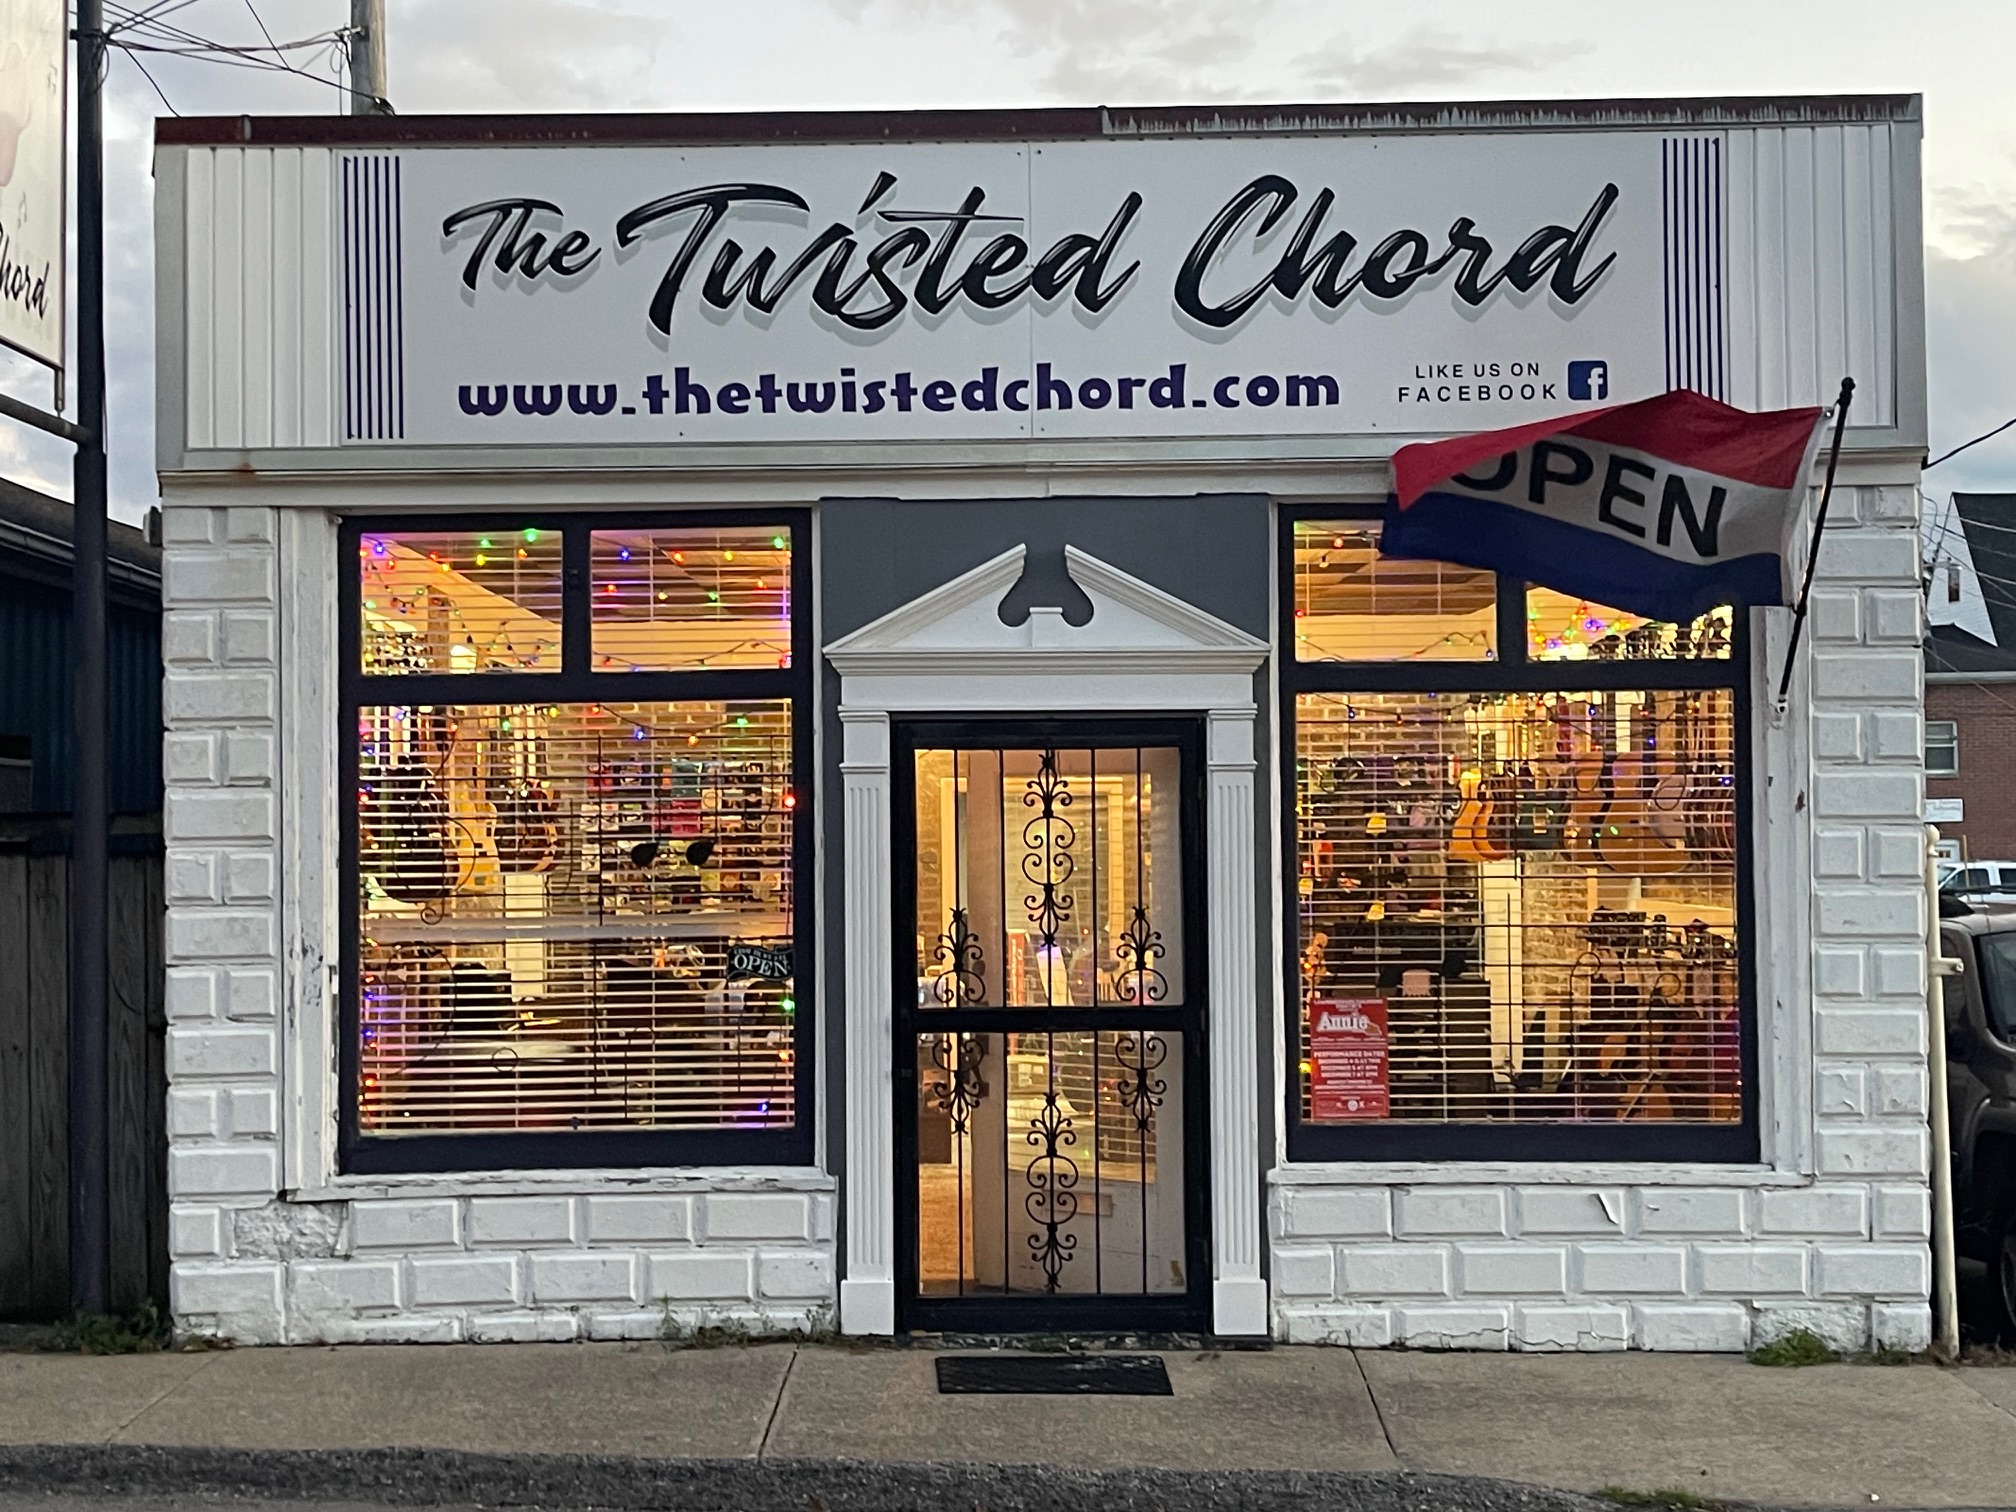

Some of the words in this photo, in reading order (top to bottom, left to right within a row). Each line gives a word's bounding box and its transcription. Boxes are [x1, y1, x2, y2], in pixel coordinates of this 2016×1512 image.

[0, 222, 49, 320] hord
[443, 198, 601, 291] The
[616, 171, 1142, 336] Twisted
[1174, 174, 1618, 328] Chord
[1415, 364, 1464, 379] LIKE
[1473, 363, 1500, 378] US
[1510, 362, 1540, 377] ON
[458, 363, 1340, 417] www.thetwistedchord.com
[1398, 384, 1557, 403] FACEBOOK
[733, 954, 788, 977] OPEN
